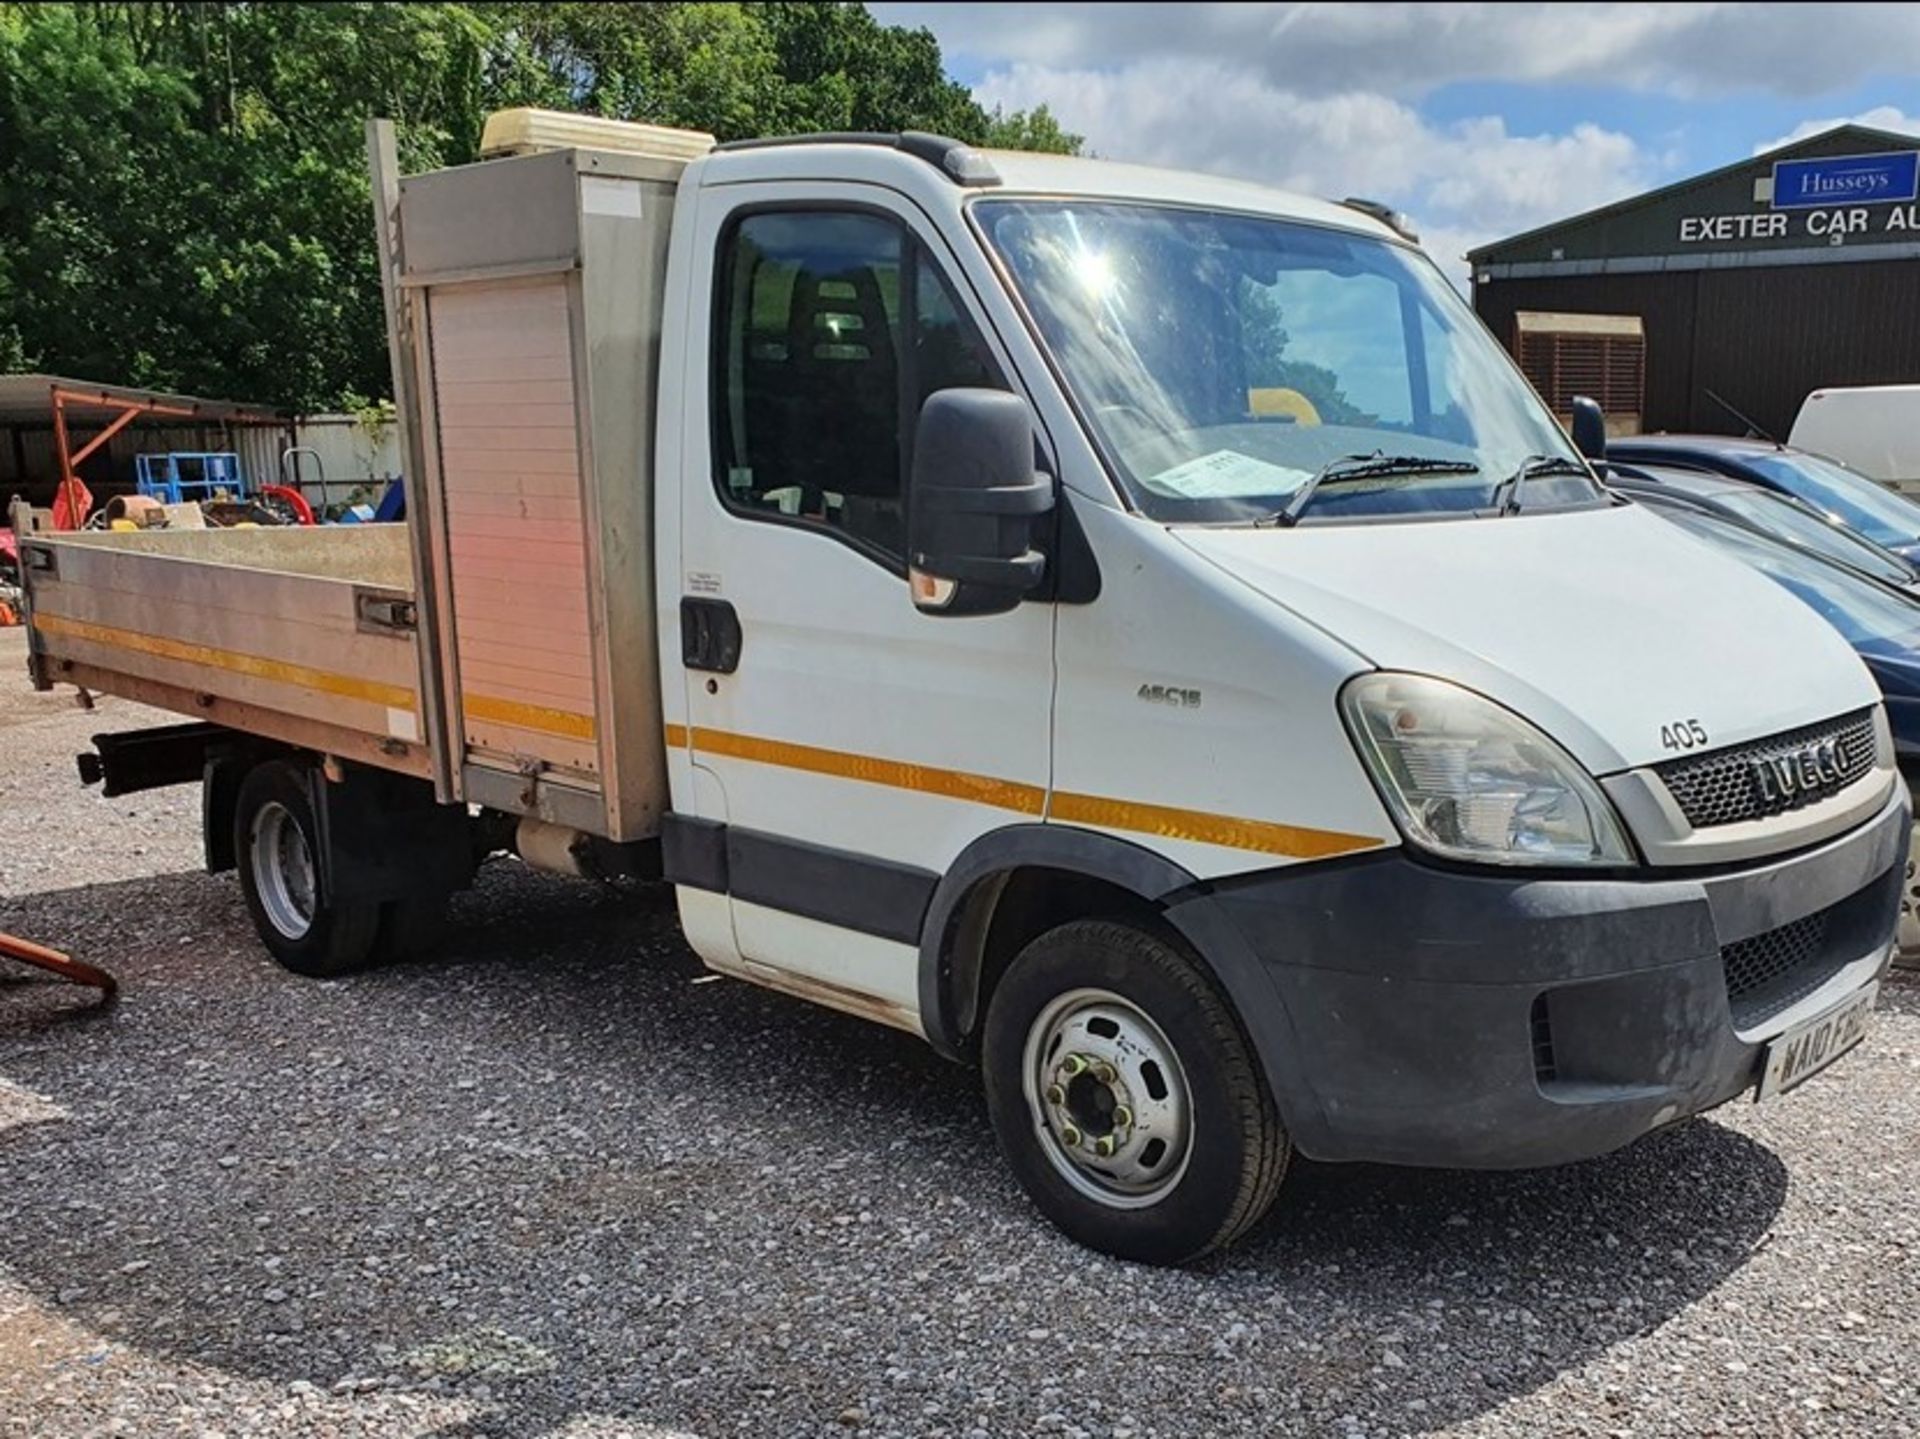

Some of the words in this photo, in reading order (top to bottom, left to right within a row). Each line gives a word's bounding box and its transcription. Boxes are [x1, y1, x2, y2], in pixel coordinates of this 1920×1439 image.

[1801, 172, 1889, 193] Husseys
[1680, 213, 1788, 241] EXETER
[1806, 208, 1869, 235] CAR
[1660, 719, 1708, 751] 405
[1755, 736, 1852, 801] IVECO
